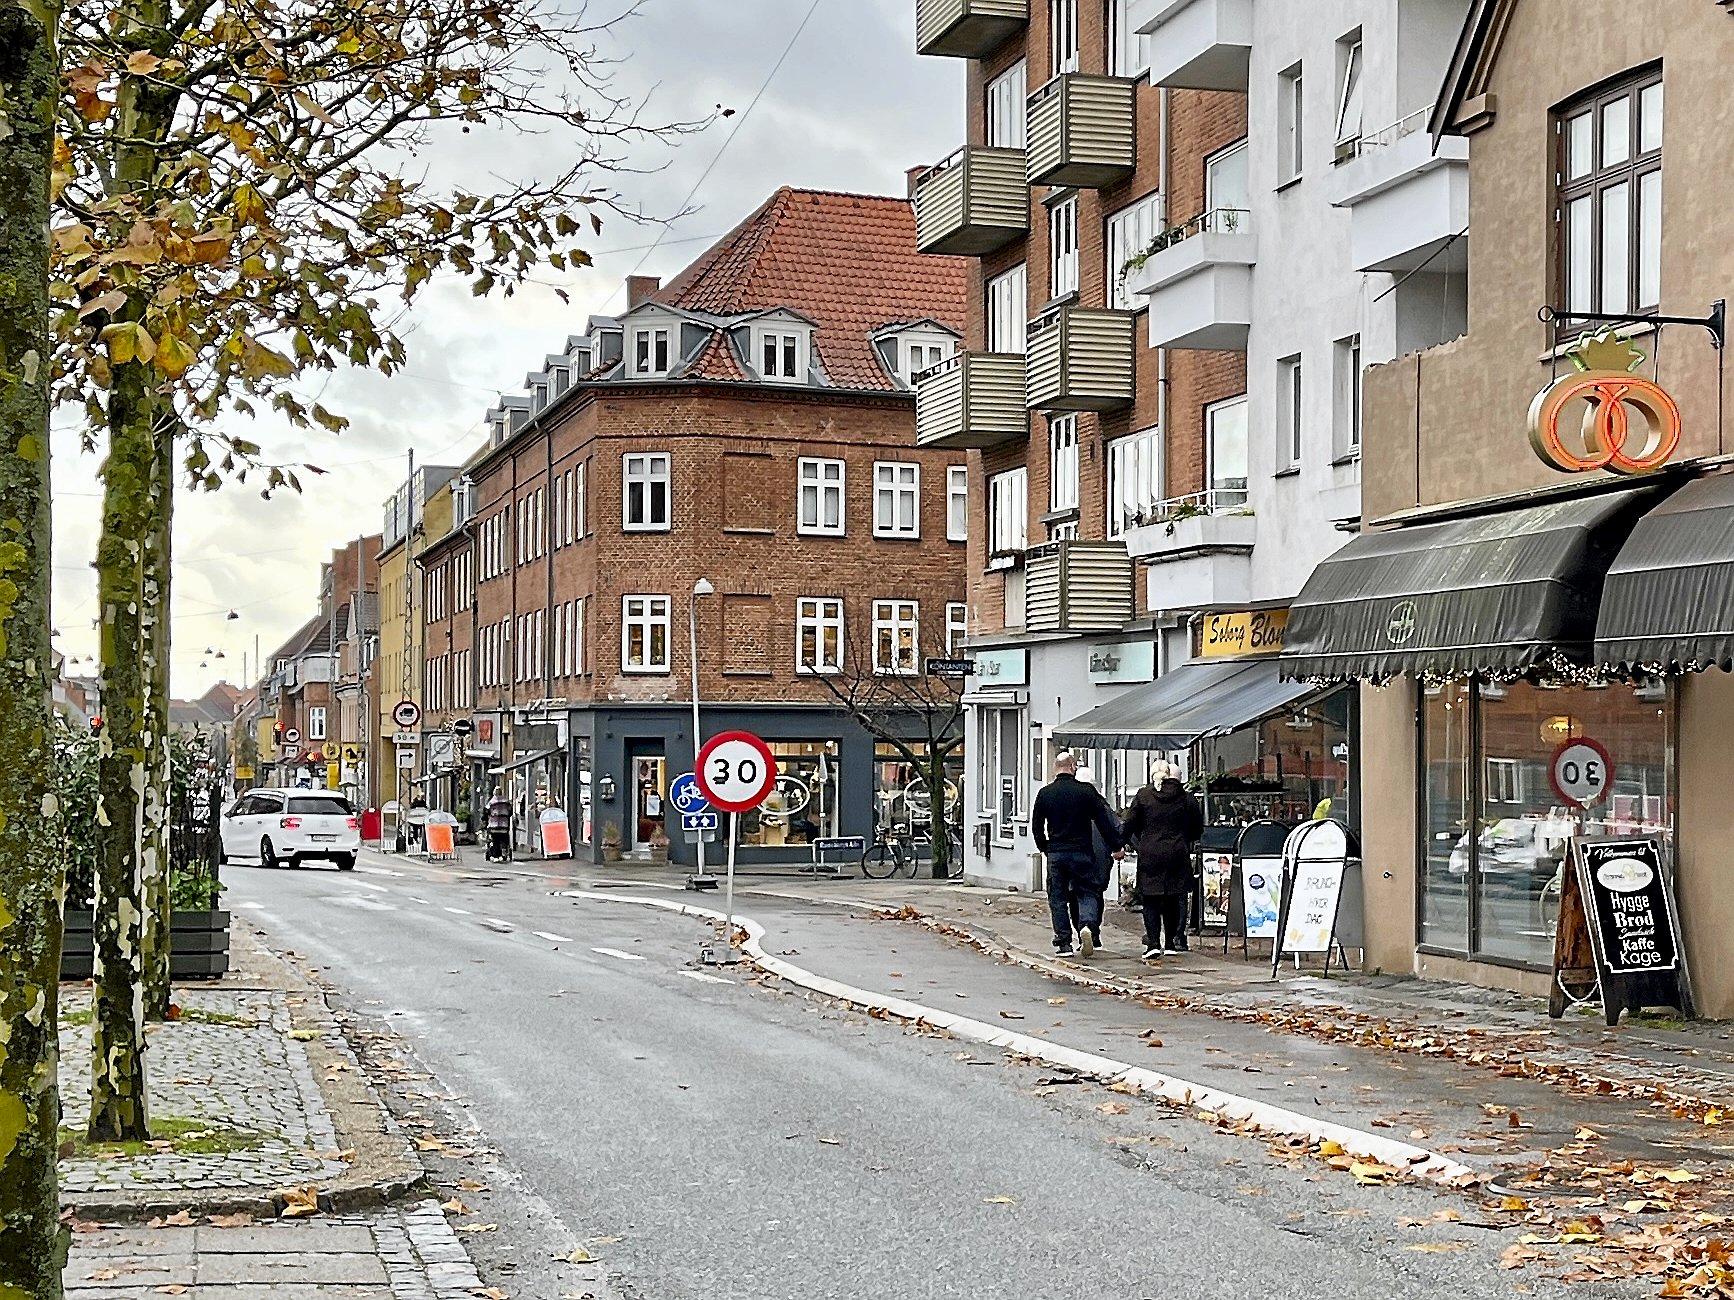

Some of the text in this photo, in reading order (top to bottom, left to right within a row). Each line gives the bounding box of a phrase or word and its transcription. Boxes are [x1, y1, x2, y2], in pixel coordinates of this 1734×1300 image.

[712, 758, 757, 784] 30
[1609, 891, 1650, 912] Hygge
[1622, 937, 1655, 951] Kaffe
[1620, 950, 1662, 967] Kage
